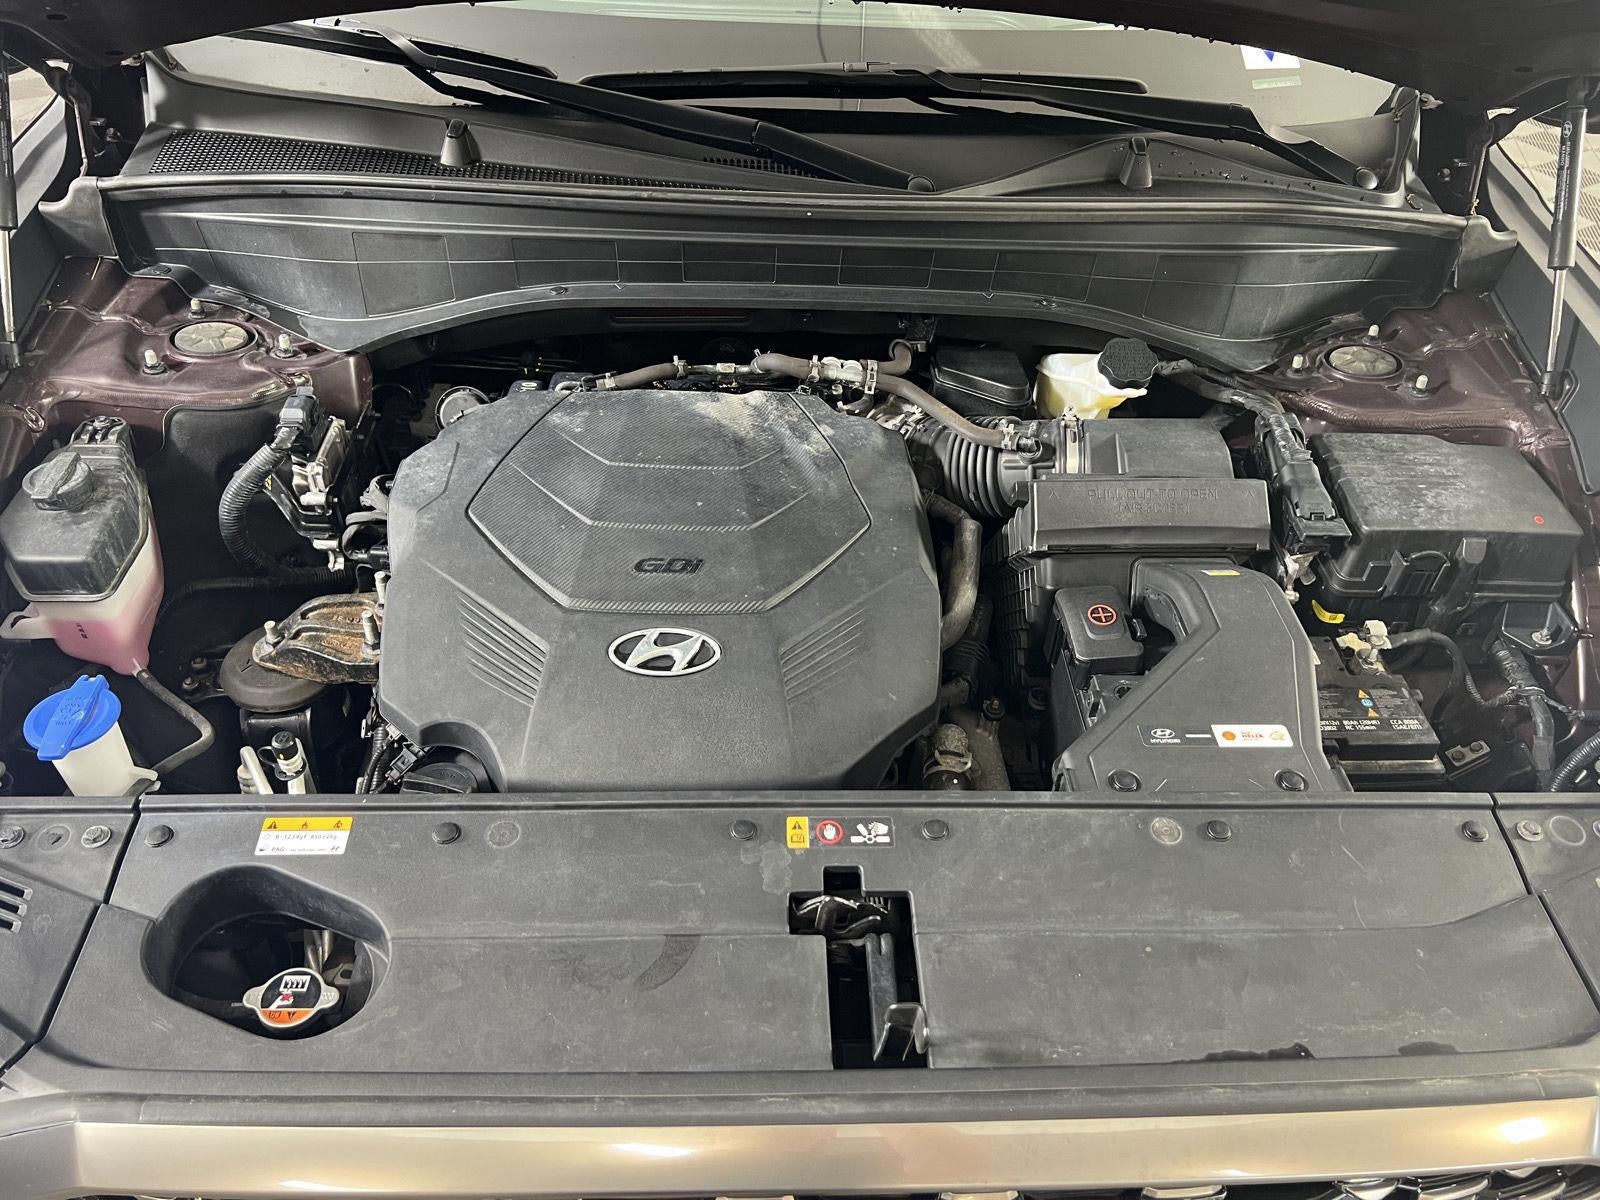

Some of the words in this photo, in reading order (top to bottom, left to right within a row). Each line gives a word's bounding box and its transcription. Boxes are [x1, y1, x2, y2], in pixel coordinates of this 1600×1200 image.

[1087, 488, 1124, 500] PULL
[1126, 488, 1153, 500] OUT
[1158, 488, 1176, 500] TO
[1181, 488, 1218, 500] OPEN
